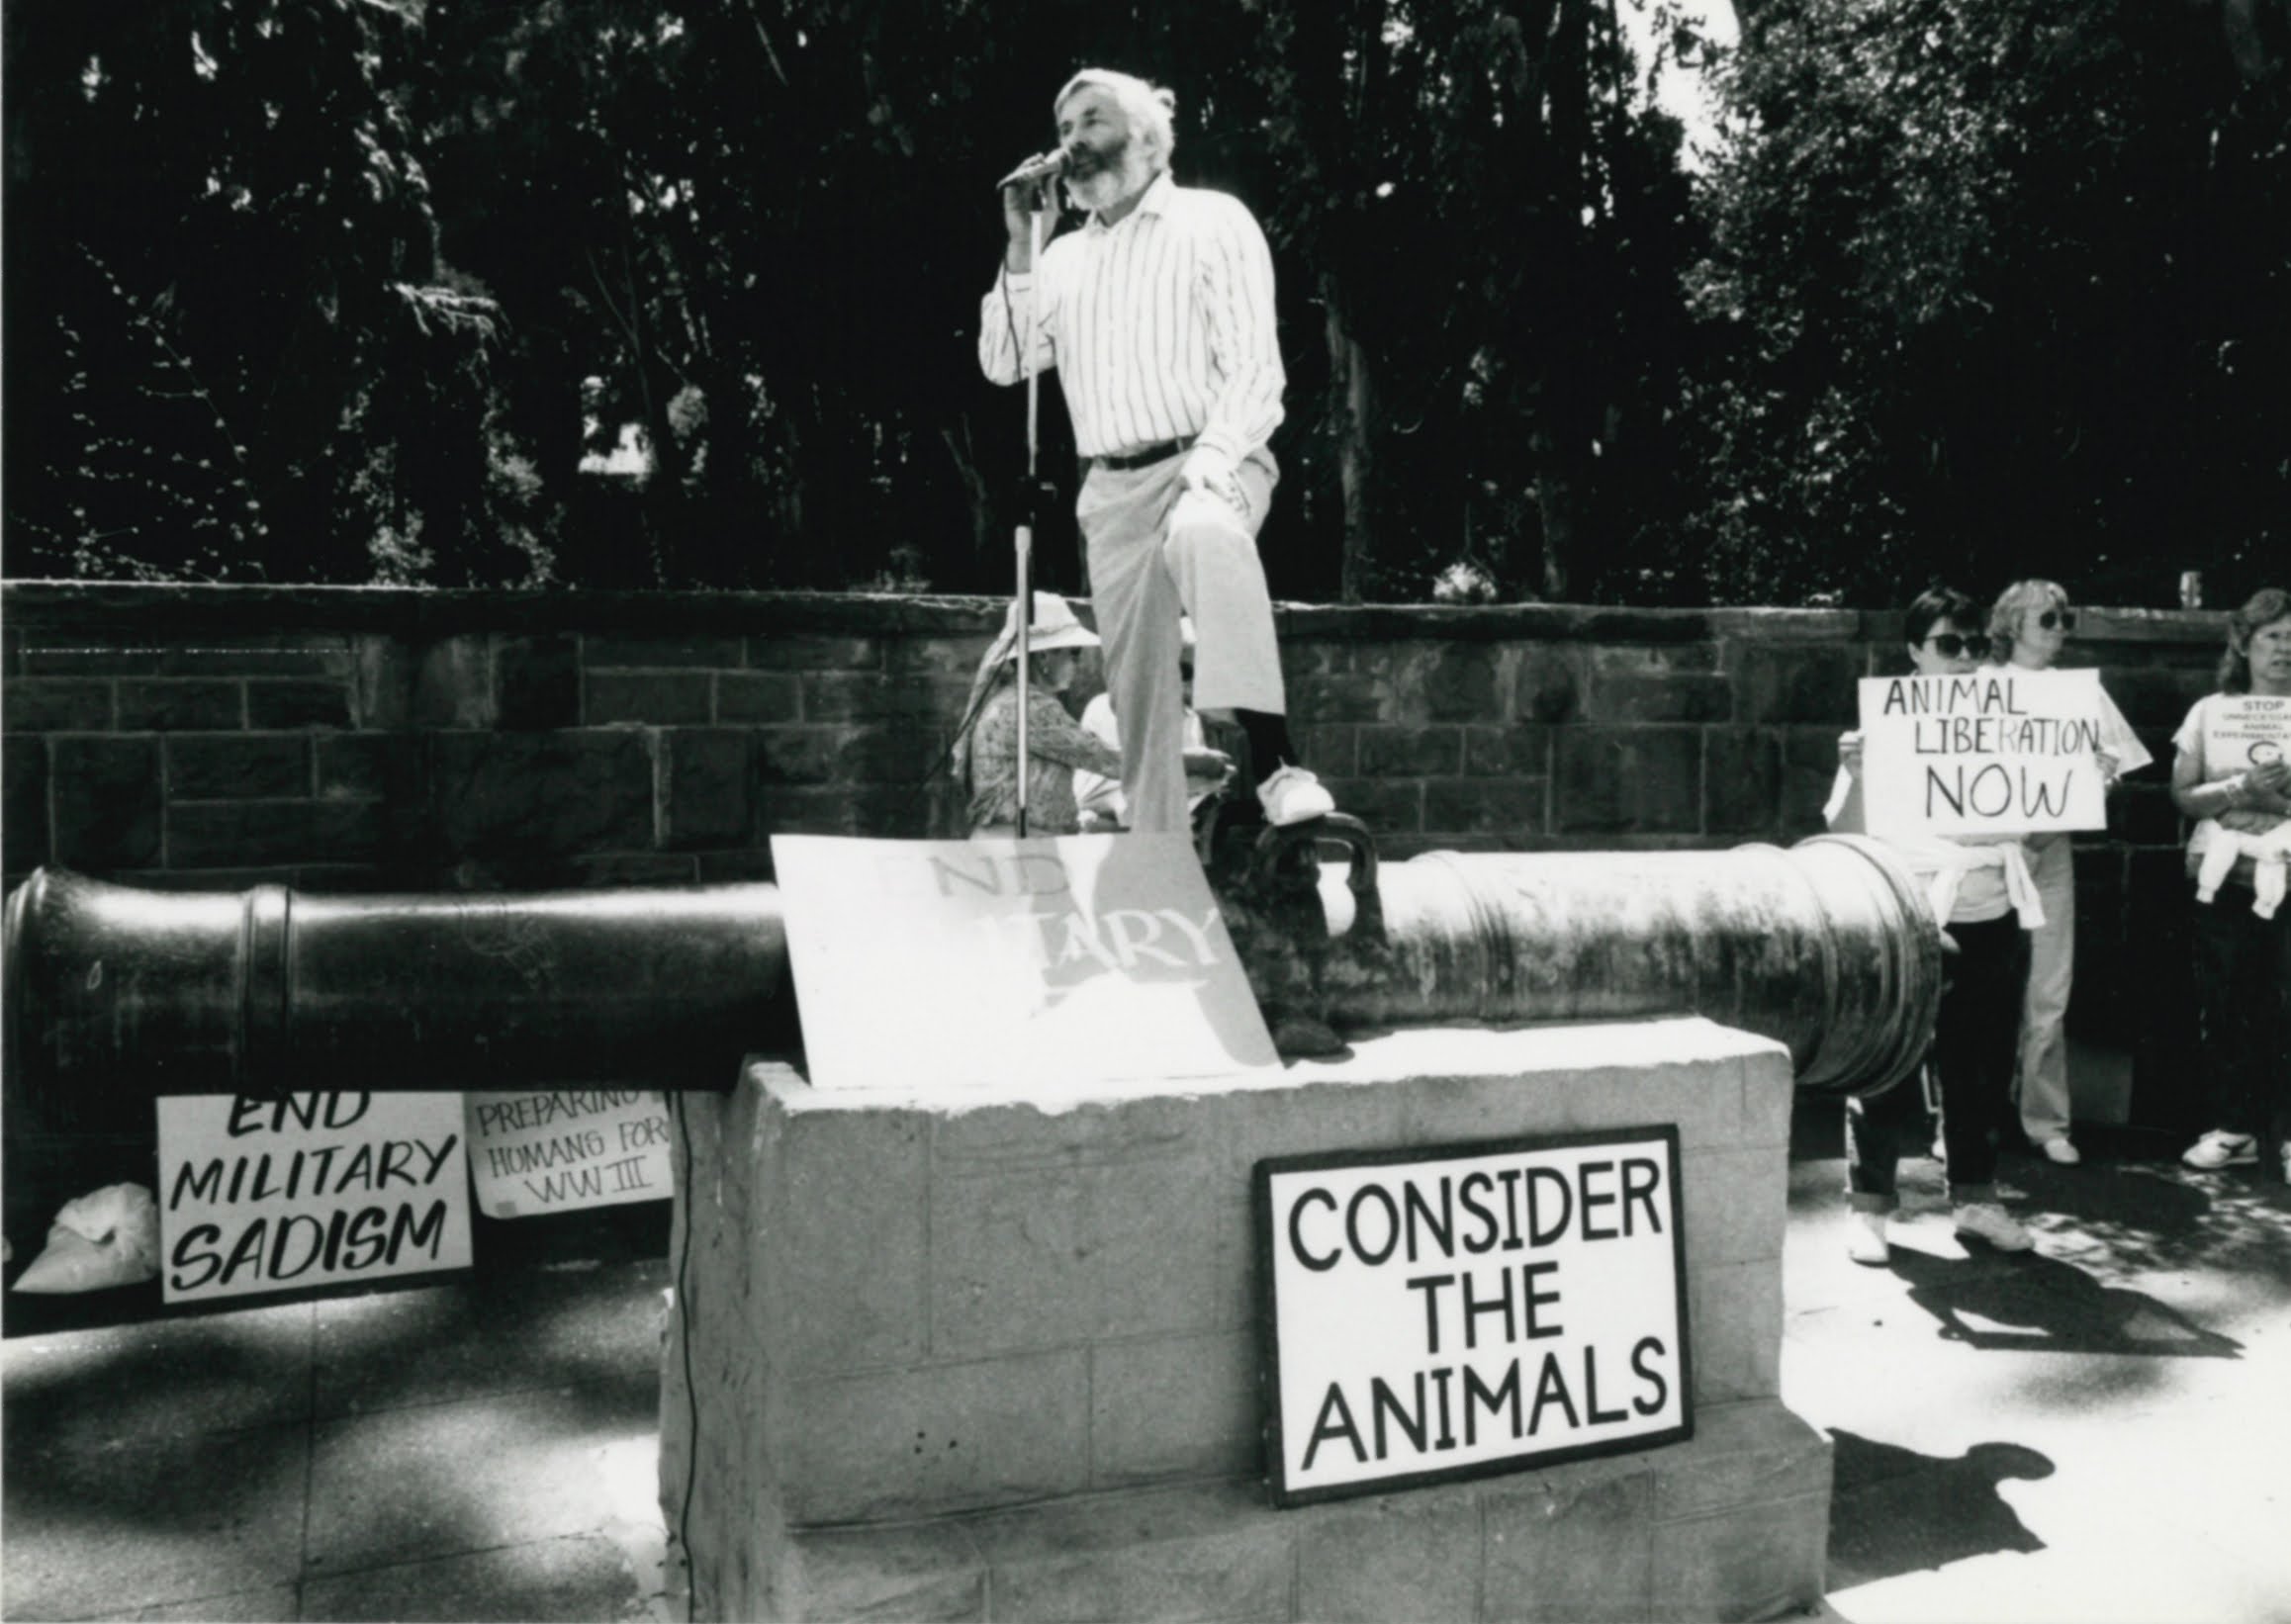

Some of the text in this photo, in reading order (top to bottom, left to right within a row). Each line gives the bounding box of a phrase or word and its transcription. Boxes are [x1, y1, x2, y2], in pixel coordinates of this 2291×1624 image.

[1882, 677, 2028, 716] ANIMAL
[2243, 699, 2286, 712] STOP
[1914, 716, 2100, 756] LIBERATION
[1925, 763, 2073, 819] NOW
[227, 1091, 370, 1137] END
[618, 1116, 670, 1153] FOR
[169, 1133, 458, 1212] MILITARY
[523, 1155, 655, 1204] WW III
[1289, 1157, 1663, 1272] CONSIDER
[170, 1199, 448, 1292] SADISM
[1406, 1261, 1564, 1355] THE
[1300, 1336, 1669, 1472] ANIMALS
